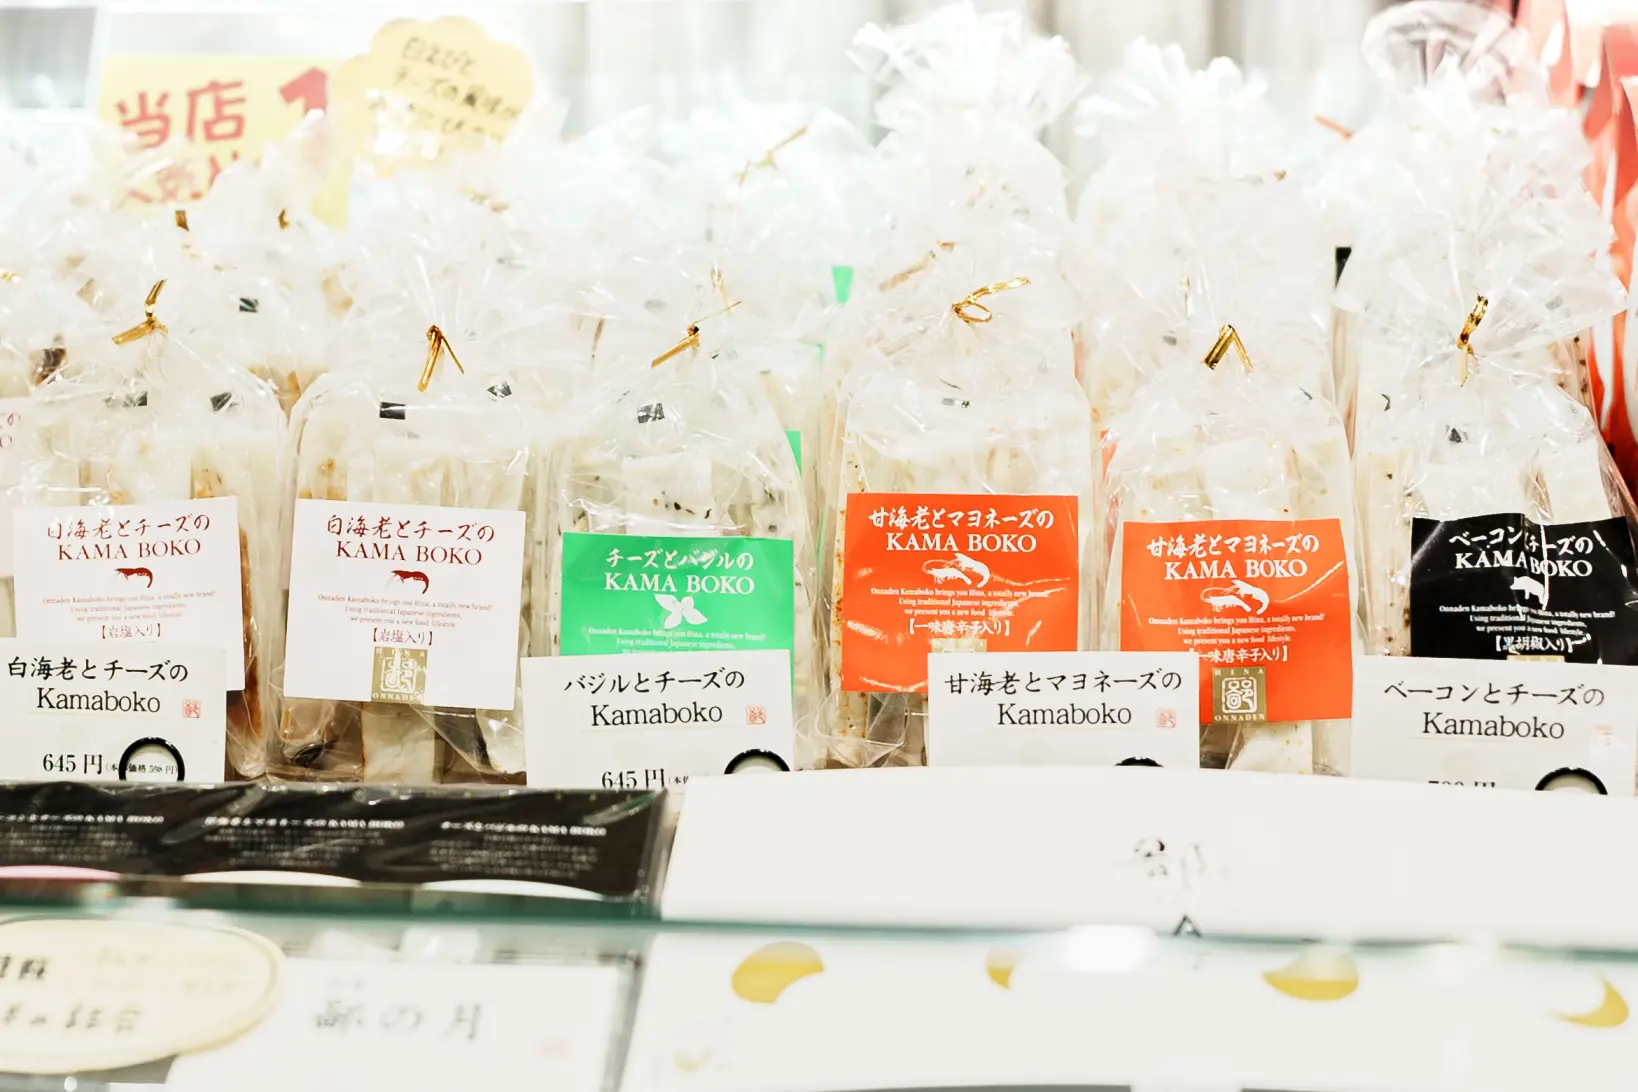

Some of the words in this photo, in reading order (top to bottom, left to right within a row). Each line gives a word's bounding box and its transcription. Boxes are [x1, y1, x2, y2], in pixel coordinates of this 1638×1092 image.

[115, 80, 247, 149] 当店
[47, 513, 210, 540] 白海老とチーズの
[327, 514, 495, 542] 白海老とチーズの
[868, 505, 1055, 530] 甘海老とマヨネーズの
[58, 543, 128, 561] KAMA
[138, 538, 201, 558] BOKO
[336, 541, 406, 561] KAMA
[416, 545, 482, 566] BOKO
[886, 532, 959, 552] KAMA
[968, 533, 1037, 553] BOKO
[1146, 533, 1319, 558] 甘海老とマヨネーズの
[606, 548, 754, 570] チーズとバジルの
[1165, 560, 1236, 580] KAMA
[1246, 558, 1307, 578] BOKO
[1455, 550, 1528, 569] KAMA
[1530, 556, 1593, 577] BOKO
[604, 572, 677, 592] KAMA
[686, 575, 755, 595] BOKO
[8, 656, 188, 682] 白海老とチーズの
[564, 667, 745, 694] バジルとチーズの
[945, 667, 1182, 696] 甘海老とマヨネーズの
[1215, 668, 1263, 676] HINA
[36, 687, 161, 713] Kamaboko
[372, 692, 423, 701] ONNADE
[1384, 681, 1604, 707] ベーコンとチーズの
[591, 702, 723, 727] Kamaboko
[997, 703, 1132, 726] Kamaboko
[1422, 711, 1565, 740] Kamaboko
[43, 753, 76, 772] 645
[83, 754, 103, 775] 円
[602, 771, 637, 789] 645
[645, 768, 665, 789] 円
